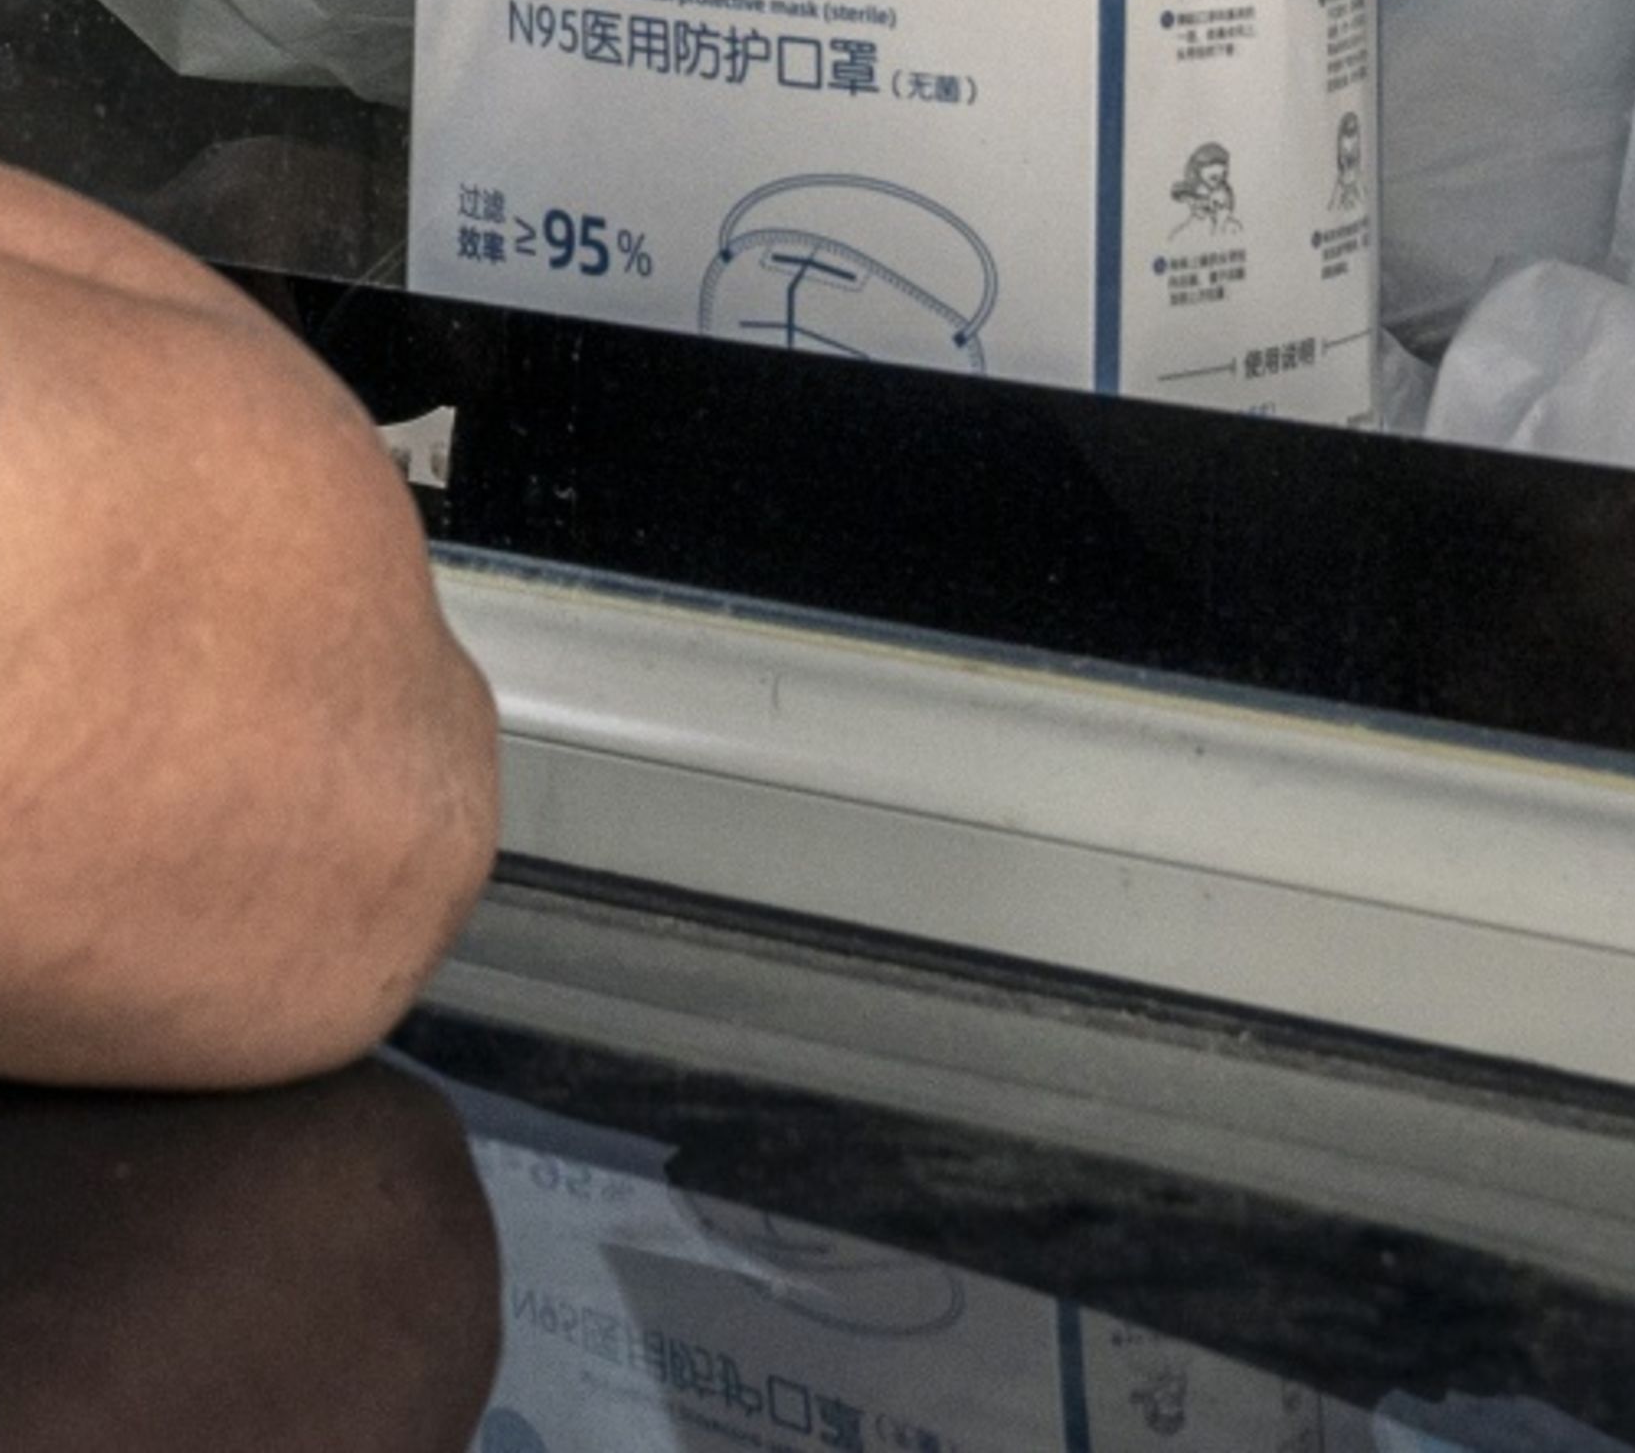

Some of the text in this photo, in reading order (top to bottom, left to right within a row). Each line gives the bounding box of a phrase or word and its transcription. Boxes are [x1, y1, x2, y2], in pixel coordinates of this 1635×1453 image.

[823, 0, 896, 29] (sterile)
[507, 0, 880, 97] N95医用防护口罩
[458, 226, 506, 264] 效率
